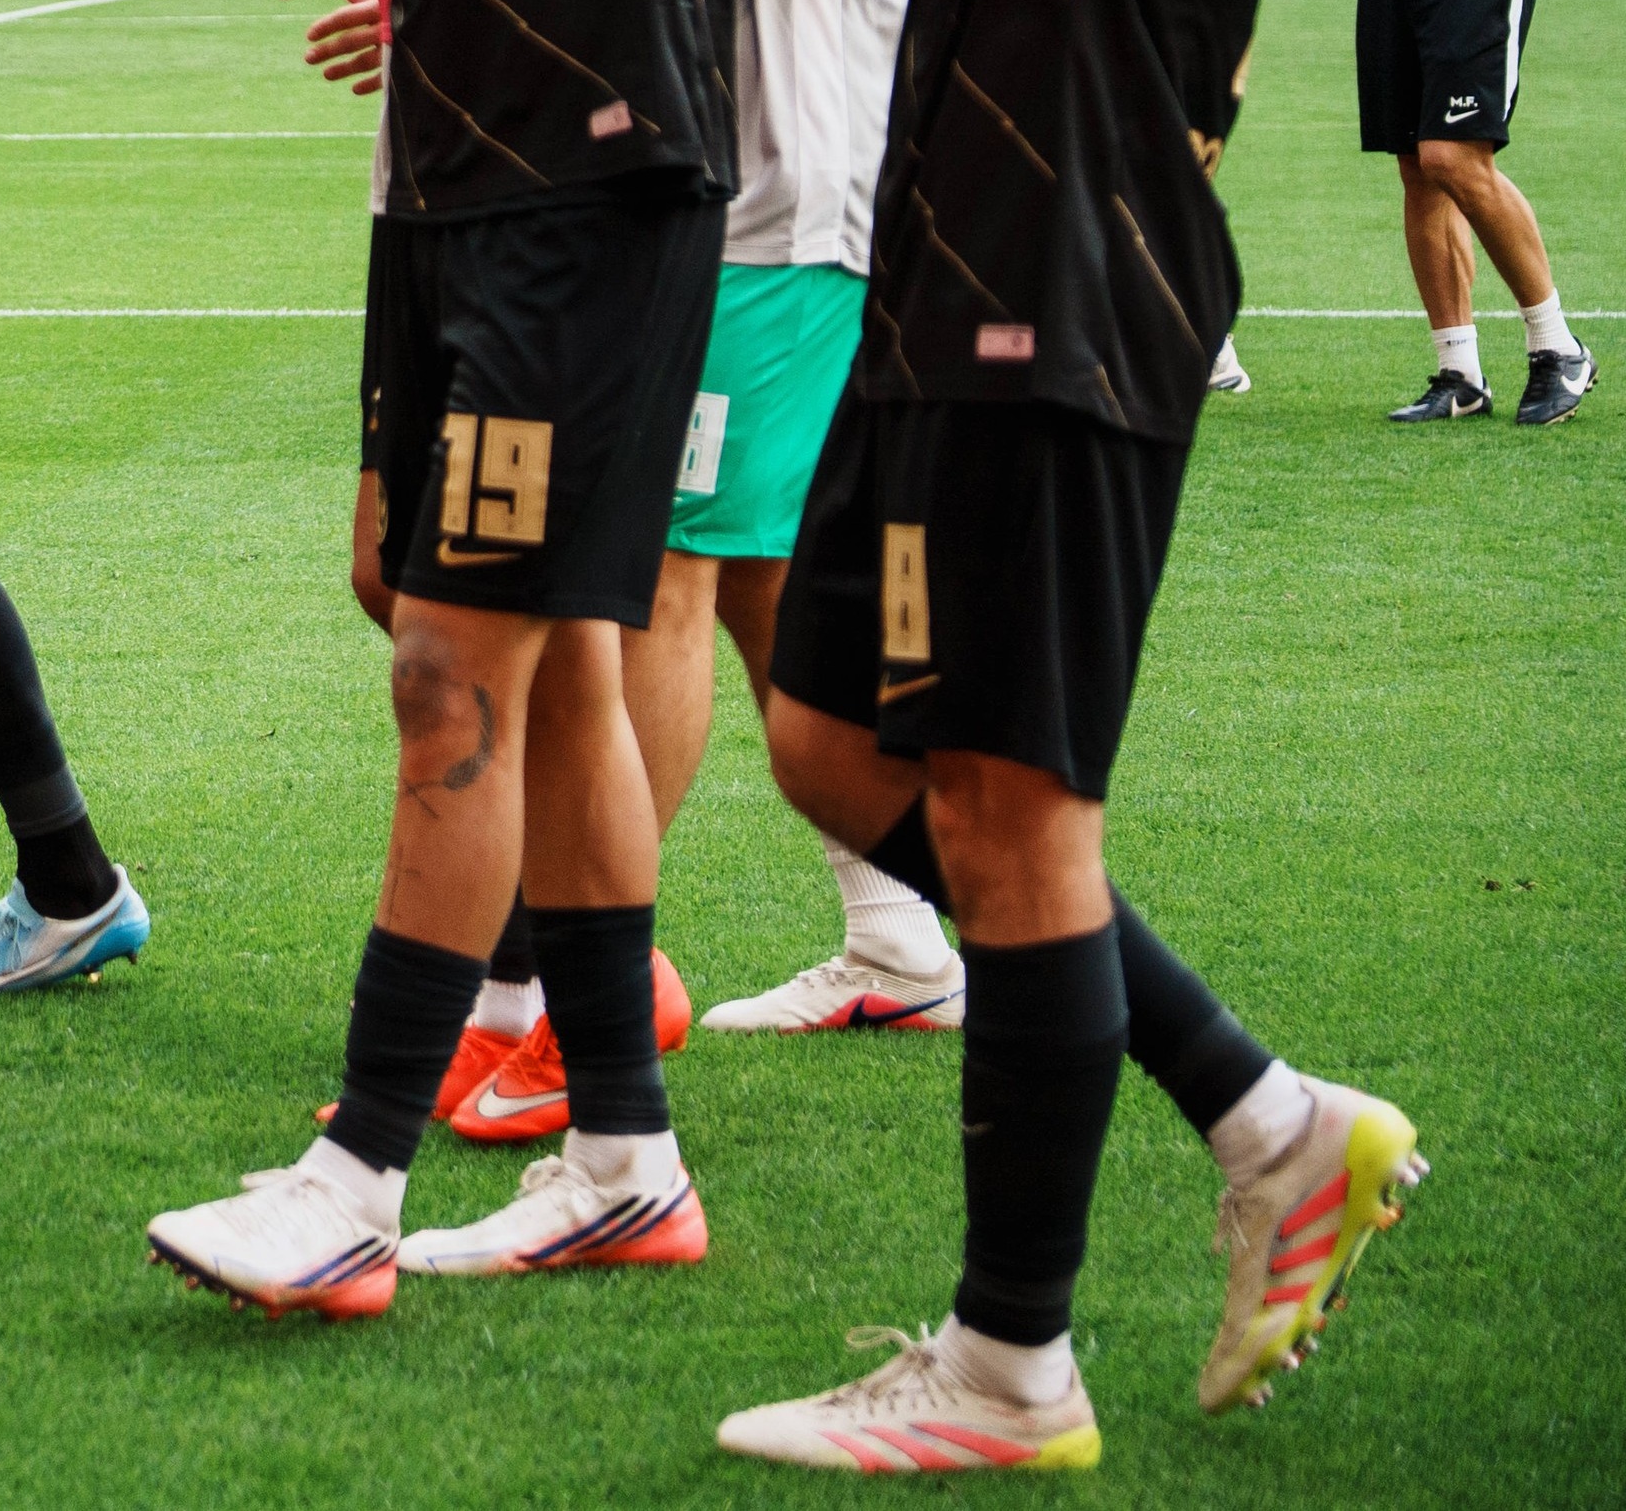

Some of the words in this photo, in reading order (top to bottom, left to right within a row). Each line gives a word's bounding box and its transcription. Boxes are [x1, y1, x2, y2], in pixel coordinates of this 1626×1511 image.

[1450, 95, 1479, 108] M.F.
[438, 412, 554, 546] 19
[881, 522, 932, 664] 8
